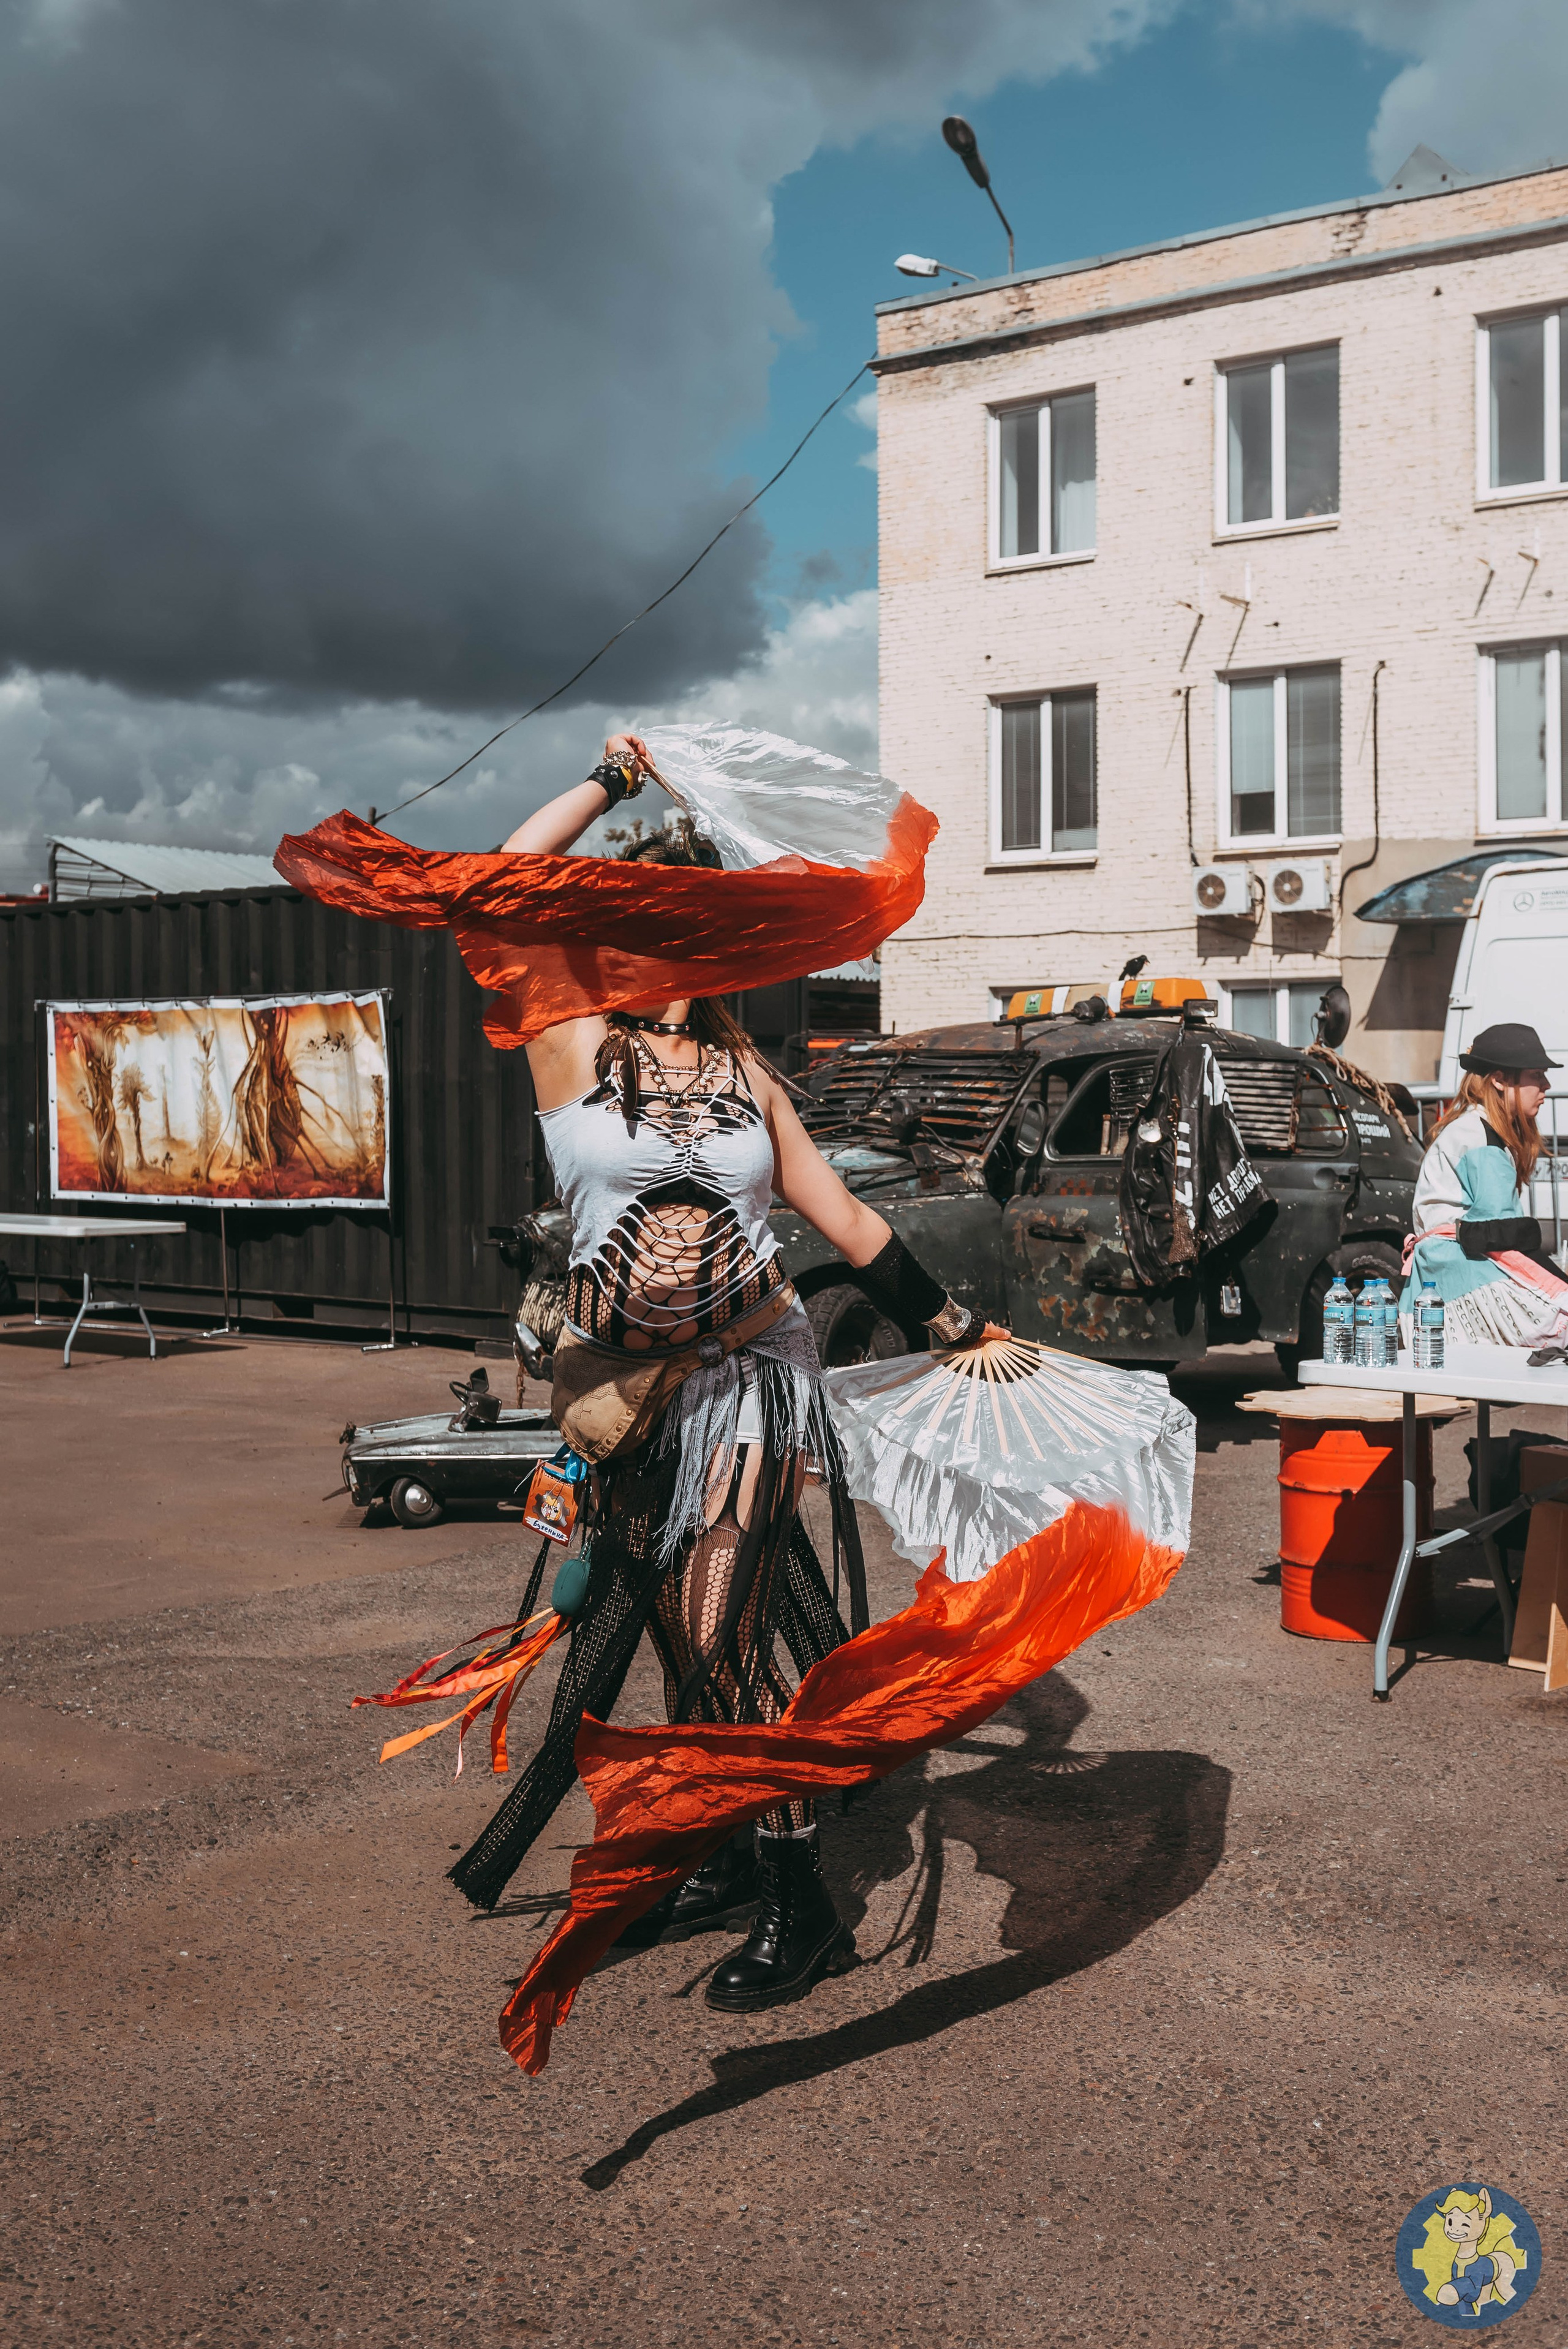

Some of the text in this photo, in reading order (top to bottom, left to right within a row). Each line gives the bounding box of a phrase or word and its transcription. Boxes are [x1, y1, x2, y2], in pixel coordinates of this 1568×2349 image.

[1208, 1182, 1225, 1205] НЕТ
[1212, 1195, 1235, 1220] НЕТ
[533, 1520, 565, 1539] Буженина
